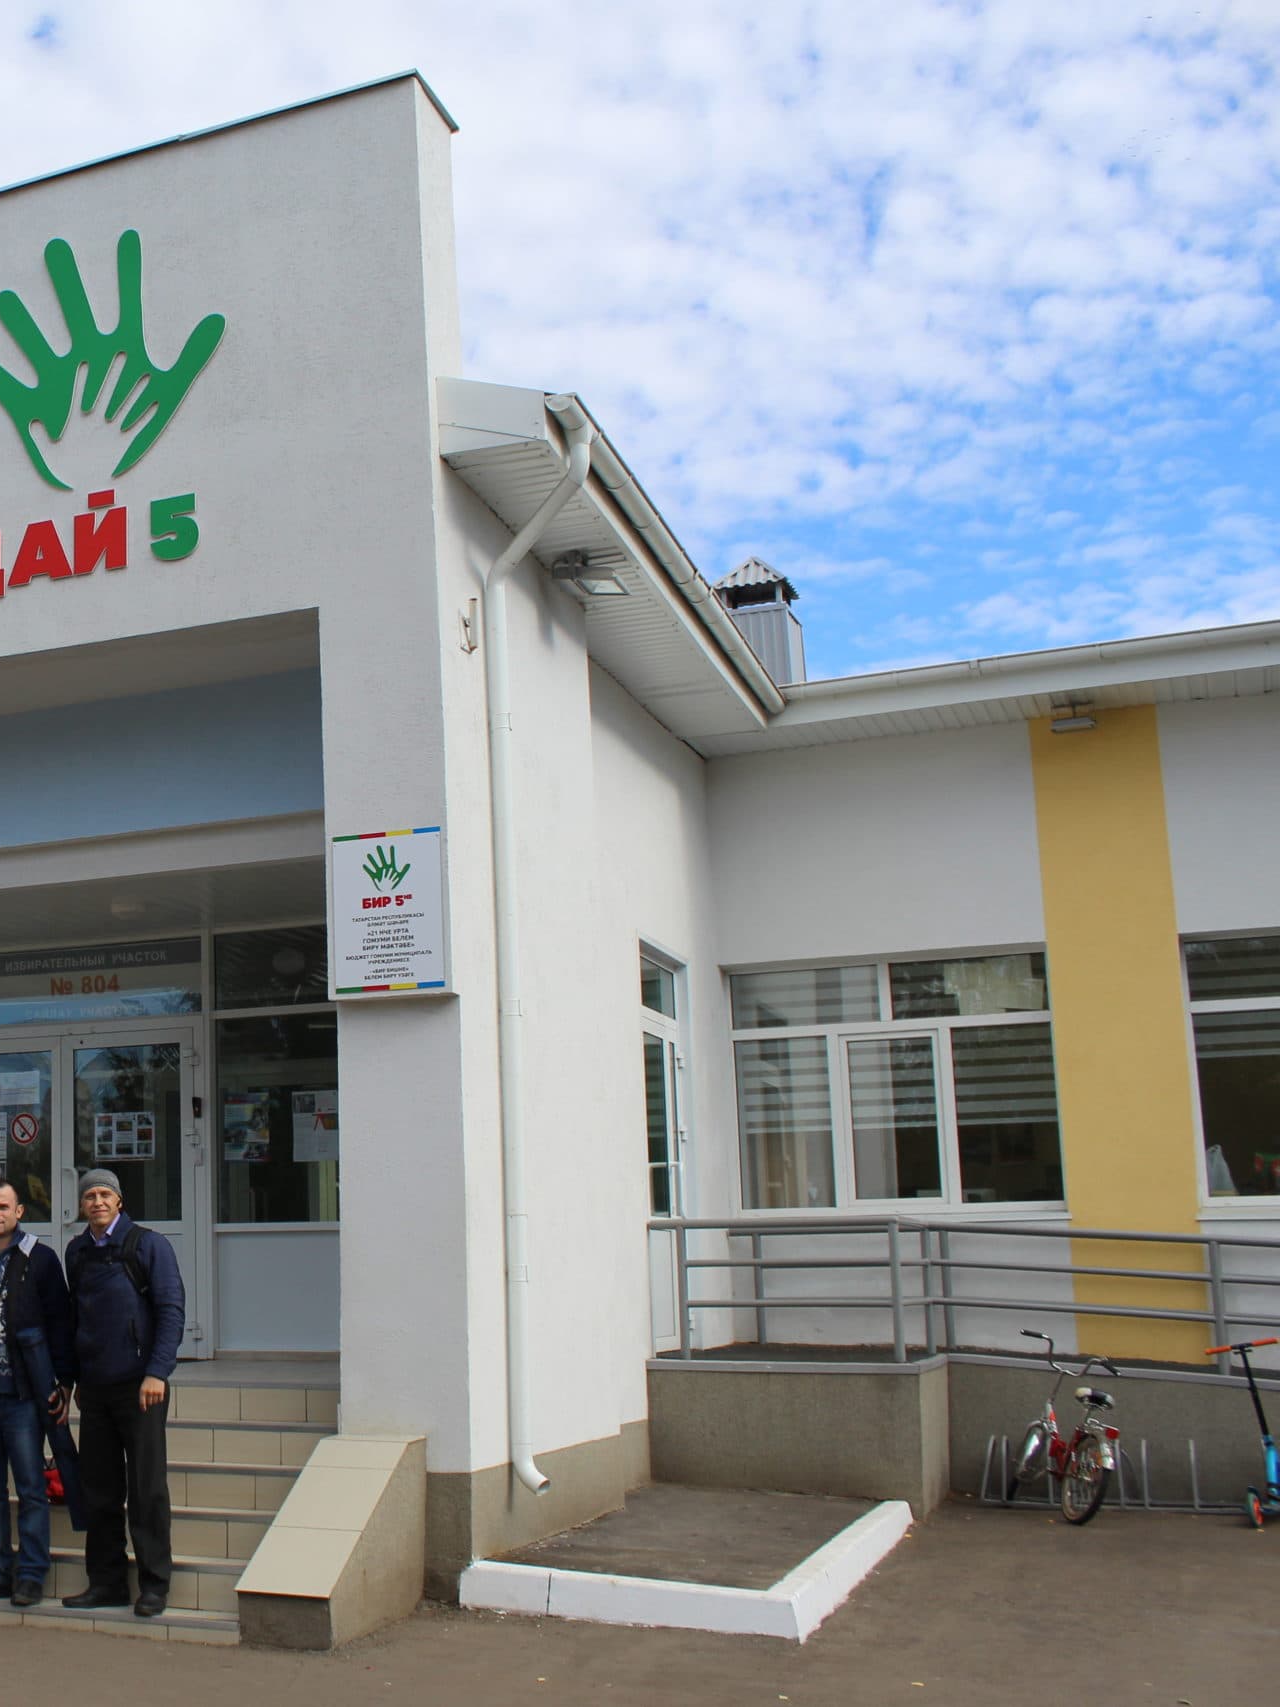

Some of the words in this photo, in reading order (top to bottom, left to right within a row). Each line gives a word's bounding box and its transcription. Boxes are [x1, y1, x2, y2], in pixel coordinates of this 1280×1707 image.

[150, 492, 200, 561] 5
[362, 896, 392, 909] БИР
[4, 955, 105, 973] ИЗБИРАТЕЛЬНЫЙ
[112, 951, 168, 964] УЧАСТОК
[50, 975, 73, 995] №
[81, 974, 120, 994] 804
